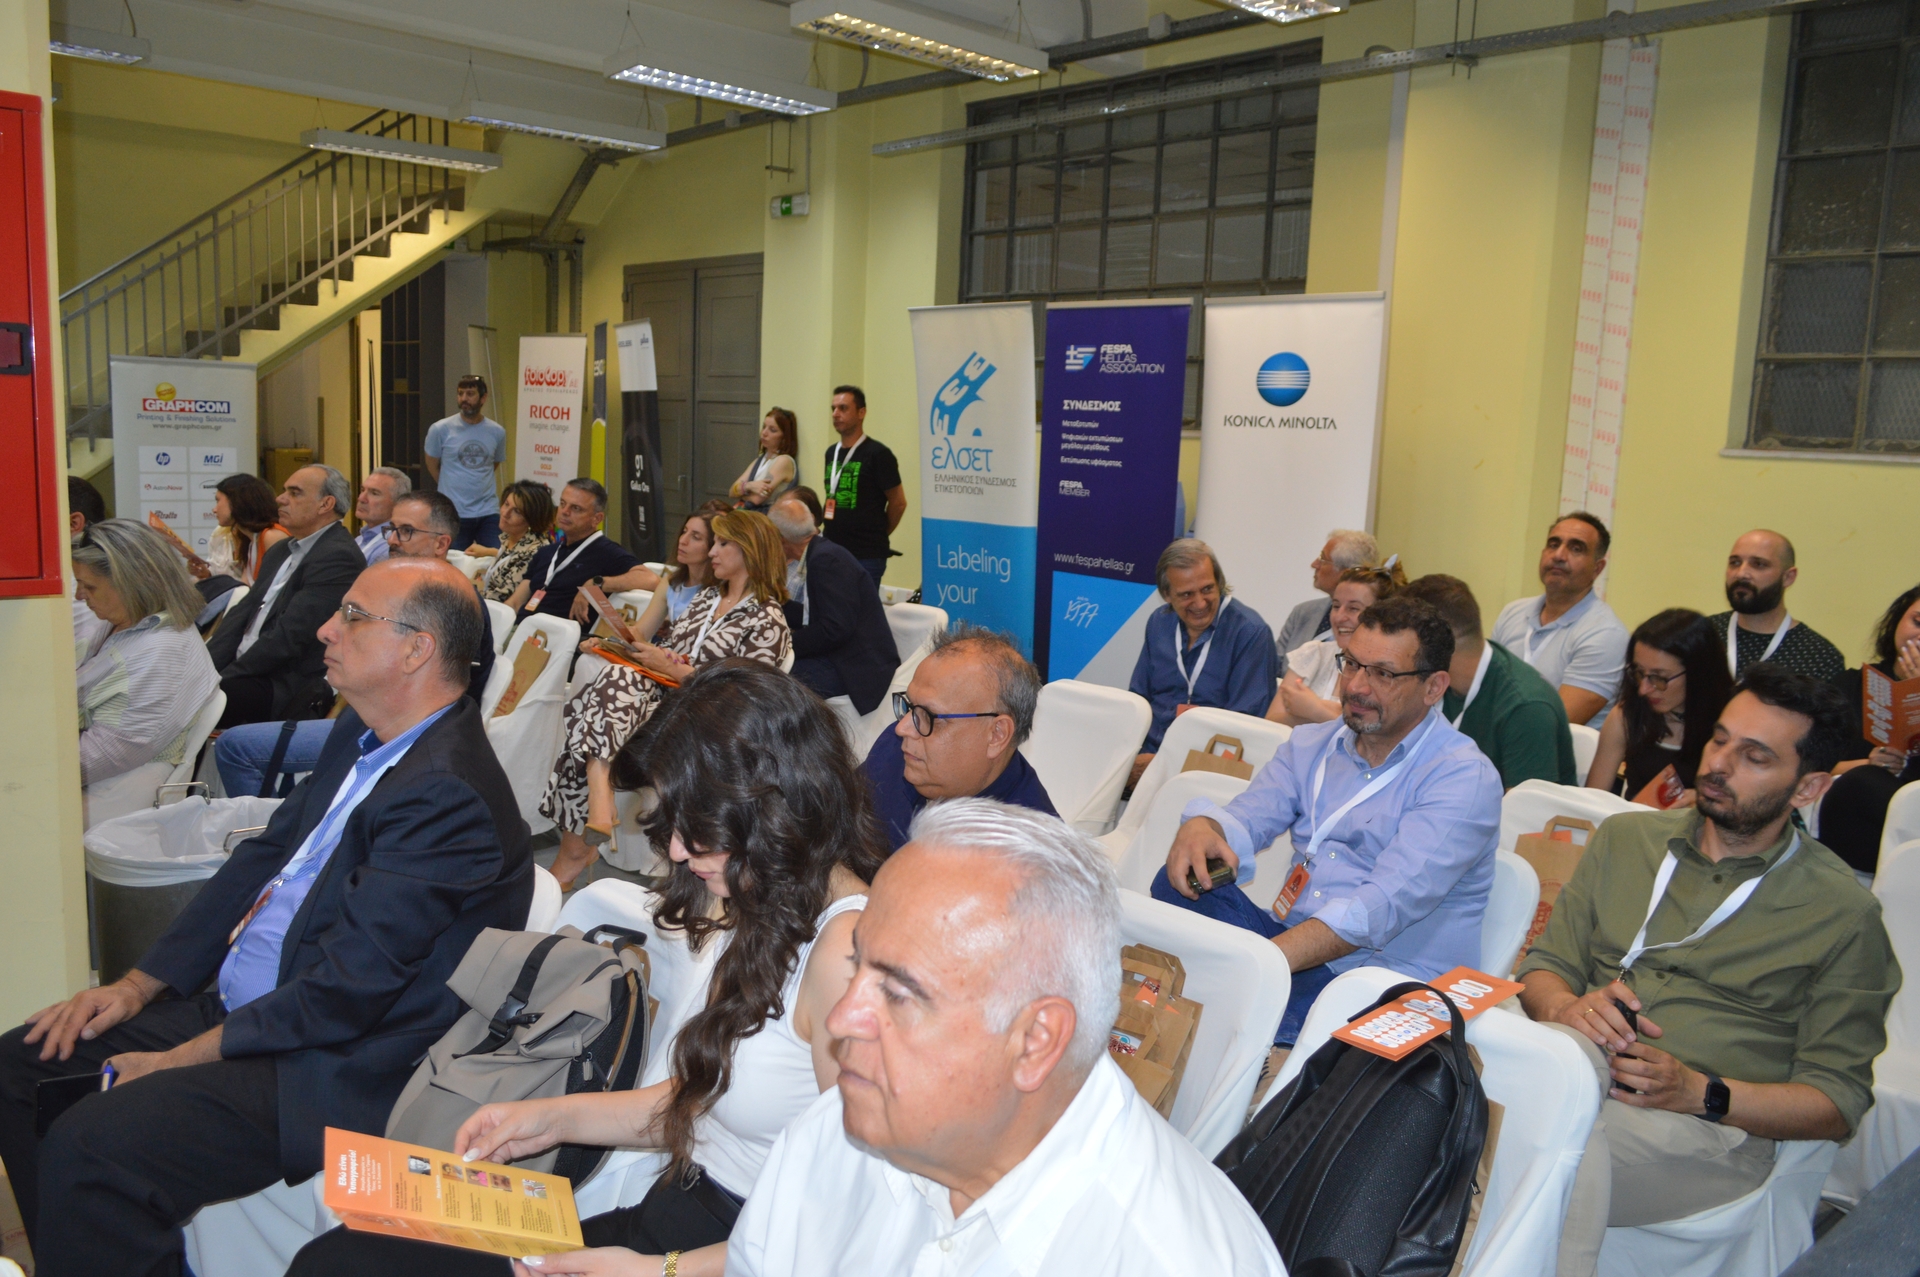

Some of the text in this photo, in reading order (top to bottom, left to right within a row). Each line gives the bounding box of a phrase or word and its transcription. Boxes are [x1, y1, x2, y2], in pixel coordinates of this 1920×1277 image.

[1100, 344, 1133, 354] FESPA
[1099, 353, 1137, 363] HELLAS
[1099, 363, 1165, 373] ASSOCIATION
[145, 399, 228, 413] GRAPHCOM
[1063, 399, 1121, 411] ΣΥΝΔΕΣΜΟΣ
[137, 413, 164, 422] Printing
[175, 415, 204, 423] Finishing
[529, 405, 571, 420] RICOH
[153, 423, 222, 431] www.graphcom.gr
[1223, 415, 1337, 430] KONICA MINOLTA
[534, 444, 560, 454] RICOH
[931, 437, 993, 472] ελσετ
[934, 473, 1017, 487] ΕΛΛΗΝΙΚΟΣ ΣΥΝΔΕΣΜΟΣ
[1059, 480, 1083, 488] FESPA
[934, 484, 984, 495] ΕΤΙΚΕΤΟΠΟΙΩΝ
[1059, 487, 1090, 496] MEMBER
[937, 544, 1011, 583] Labeling
[1053, 553, 1135, 575] www.fespahellas.gr
[936, 583, 979, 607] your
[1064, 600, 1099, 628] 1977
